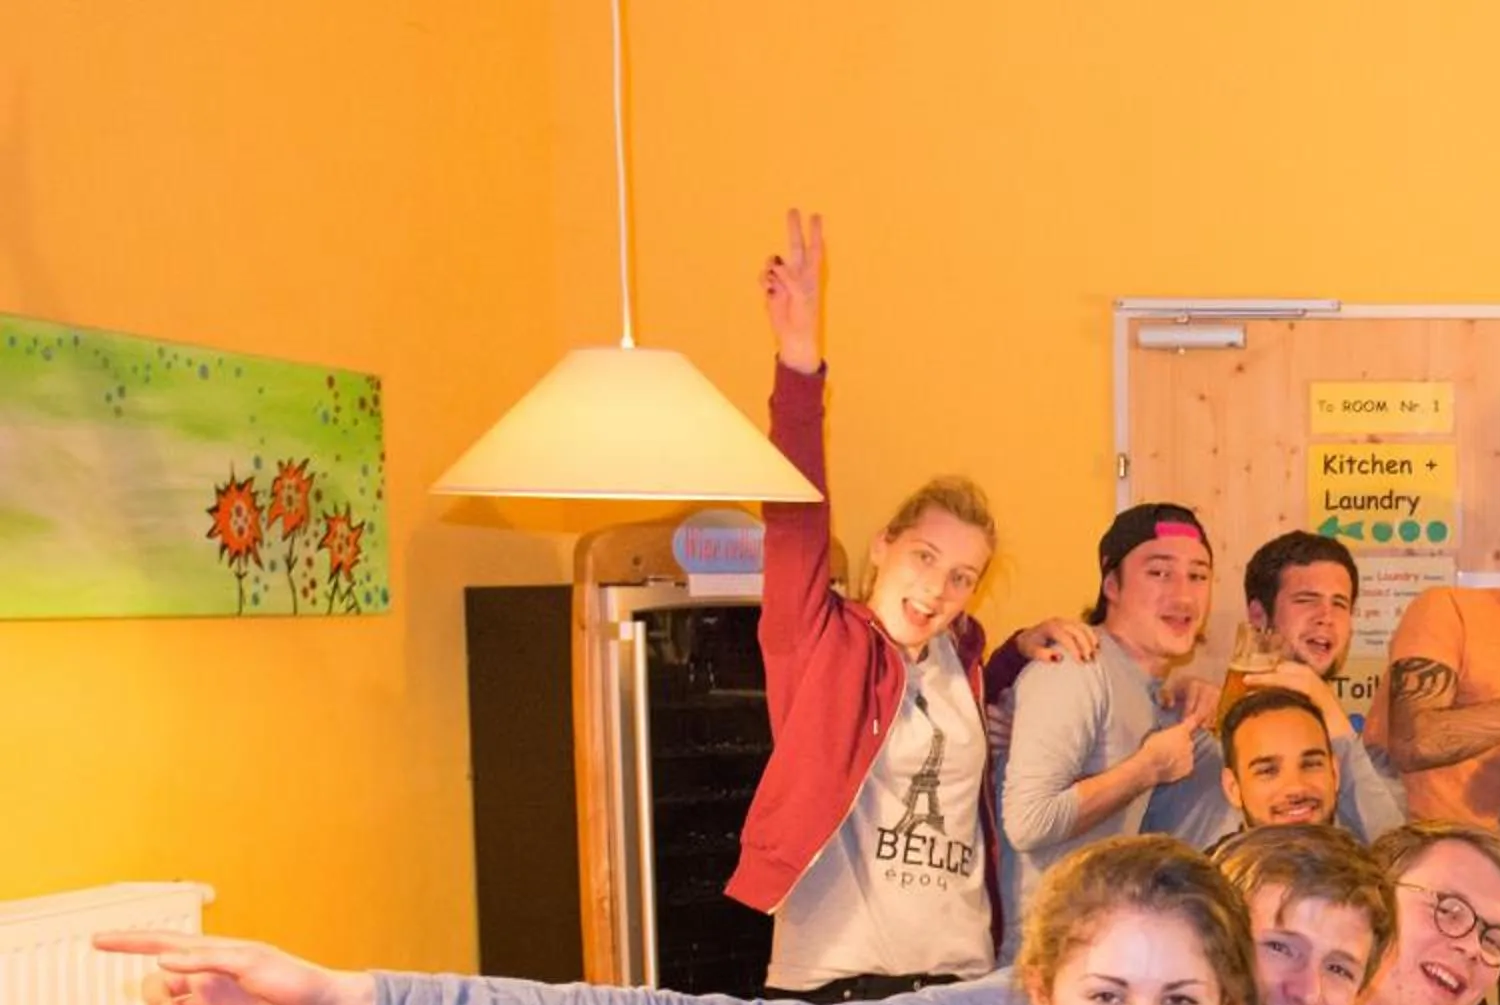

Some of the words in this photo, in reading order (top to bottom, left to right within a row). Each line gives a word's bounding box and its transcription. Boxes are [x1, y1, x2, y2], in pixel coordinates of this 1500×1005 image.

[1318, 399, 1335, 413] To
[1342, 399, 1387, 413] ROOM
[1433, 399, 1440, 413] 1
[1323, 453, 1413, 475] Kitchen
[1324, 489, 1421, 516] Laundry
[876, 827, 972, 878] BELLE
